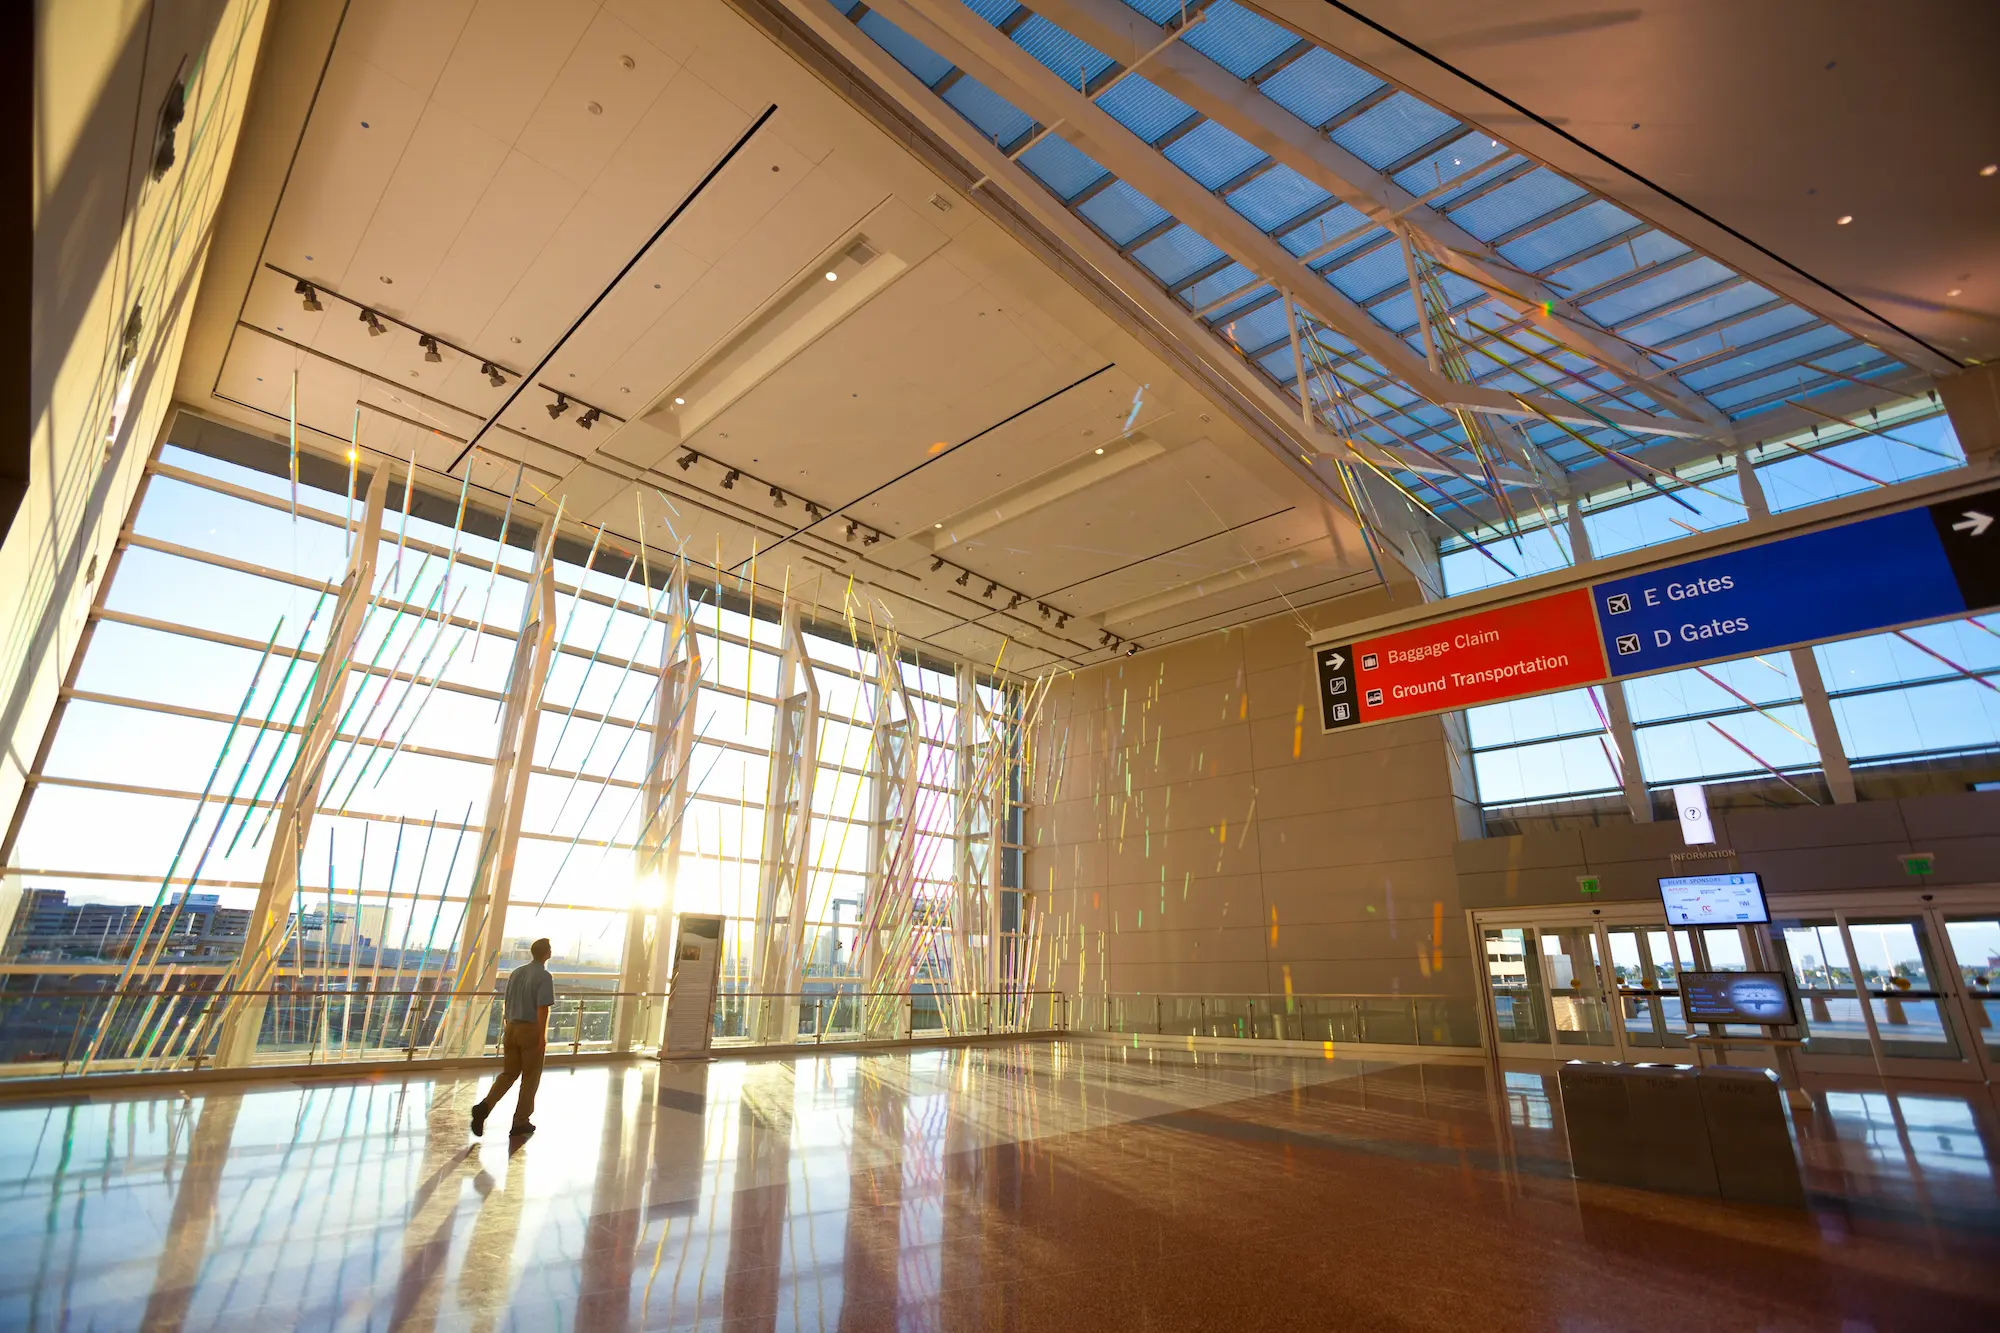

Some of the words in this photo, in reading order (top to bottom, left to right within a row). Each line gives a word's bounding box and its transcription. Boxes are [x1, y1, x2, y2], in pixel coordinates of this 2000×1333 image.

[1643, 587, 1661, 607] E
[1666, 575, 1734, 601] Gates
[1387, 639, 1450, 664] Baggage
[1454, 628, 1500, 649] Claim
[1653, 629, 1672, 648] D
[1679, 616, 1749, 642] Gates
[1391, 676, 1447, 699] Ground
[1450, 653, 1569, 688] Transportation
[1670, 849, 1736, 861] INFORMATION
[1689, 877, 1721, 885] SPONSORS
